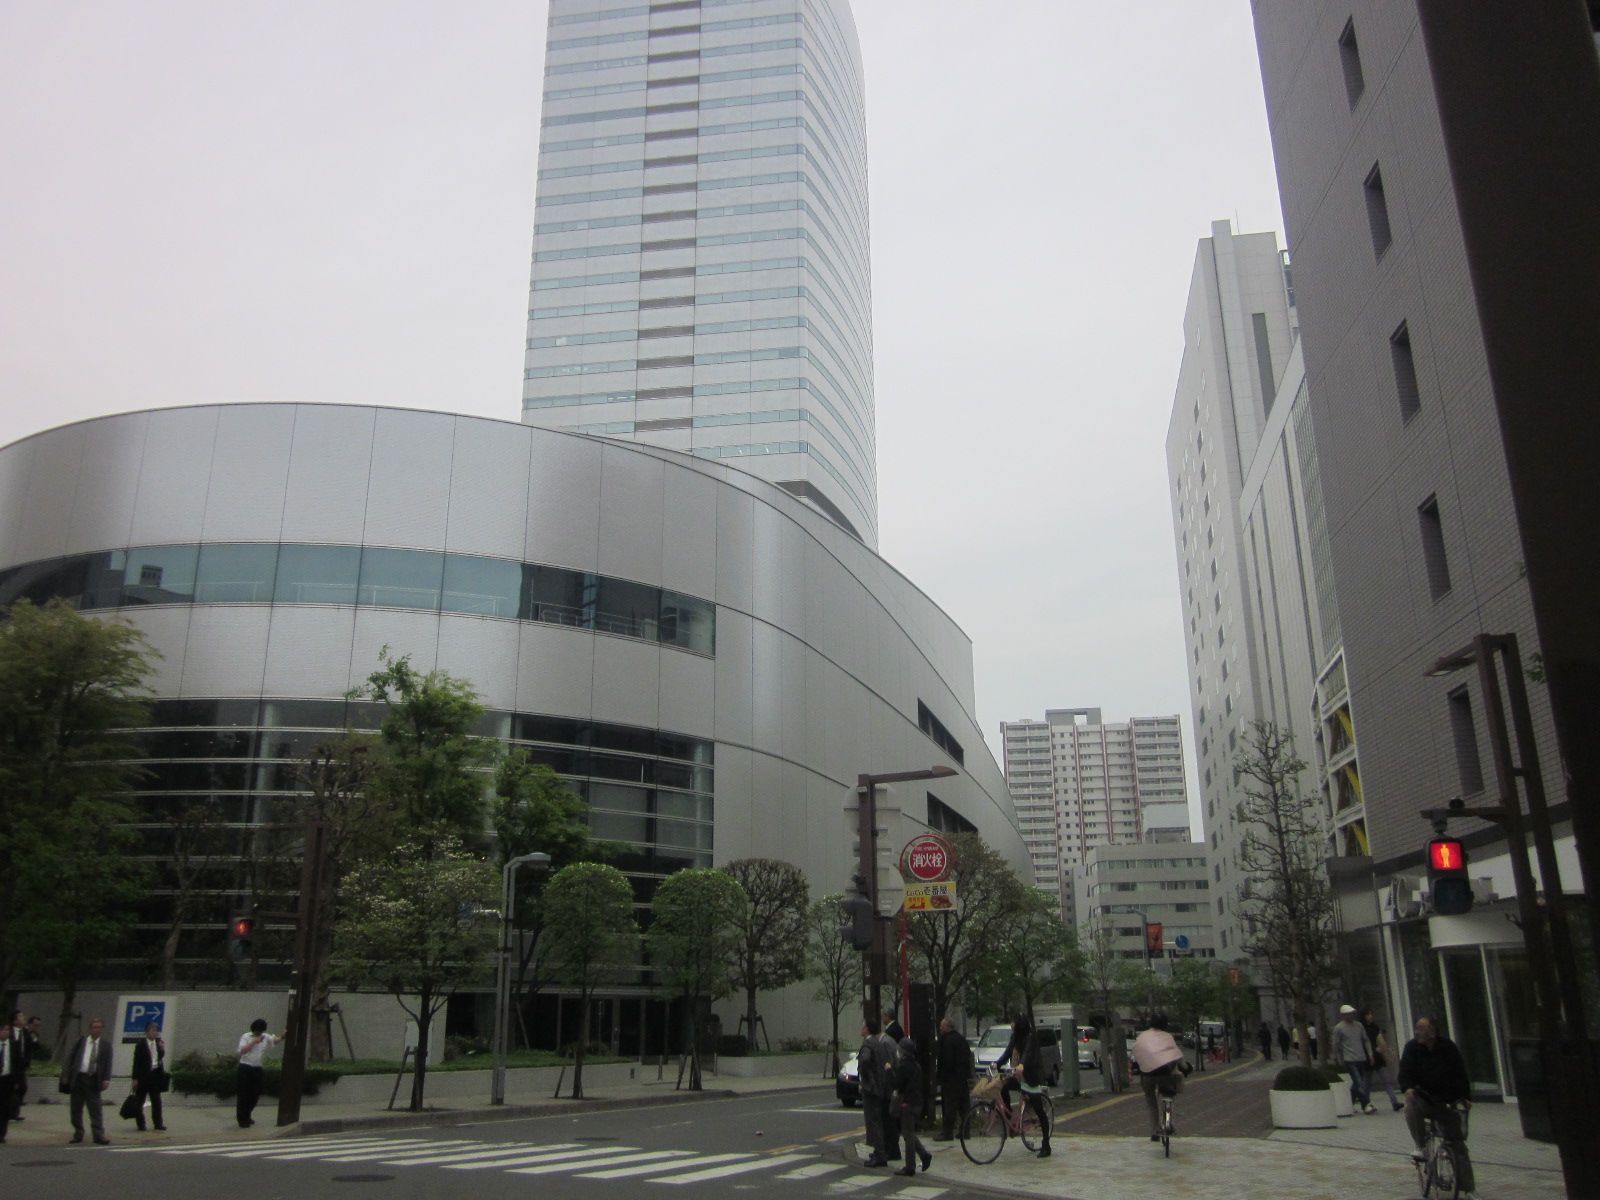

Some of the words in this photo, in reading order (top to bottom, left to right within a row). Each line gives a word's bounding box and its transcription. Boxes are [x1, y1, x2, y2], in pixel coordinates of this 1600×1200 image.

[913, 853, 943, 868] 消火栓
[130, 1005, 145, 1023] P
